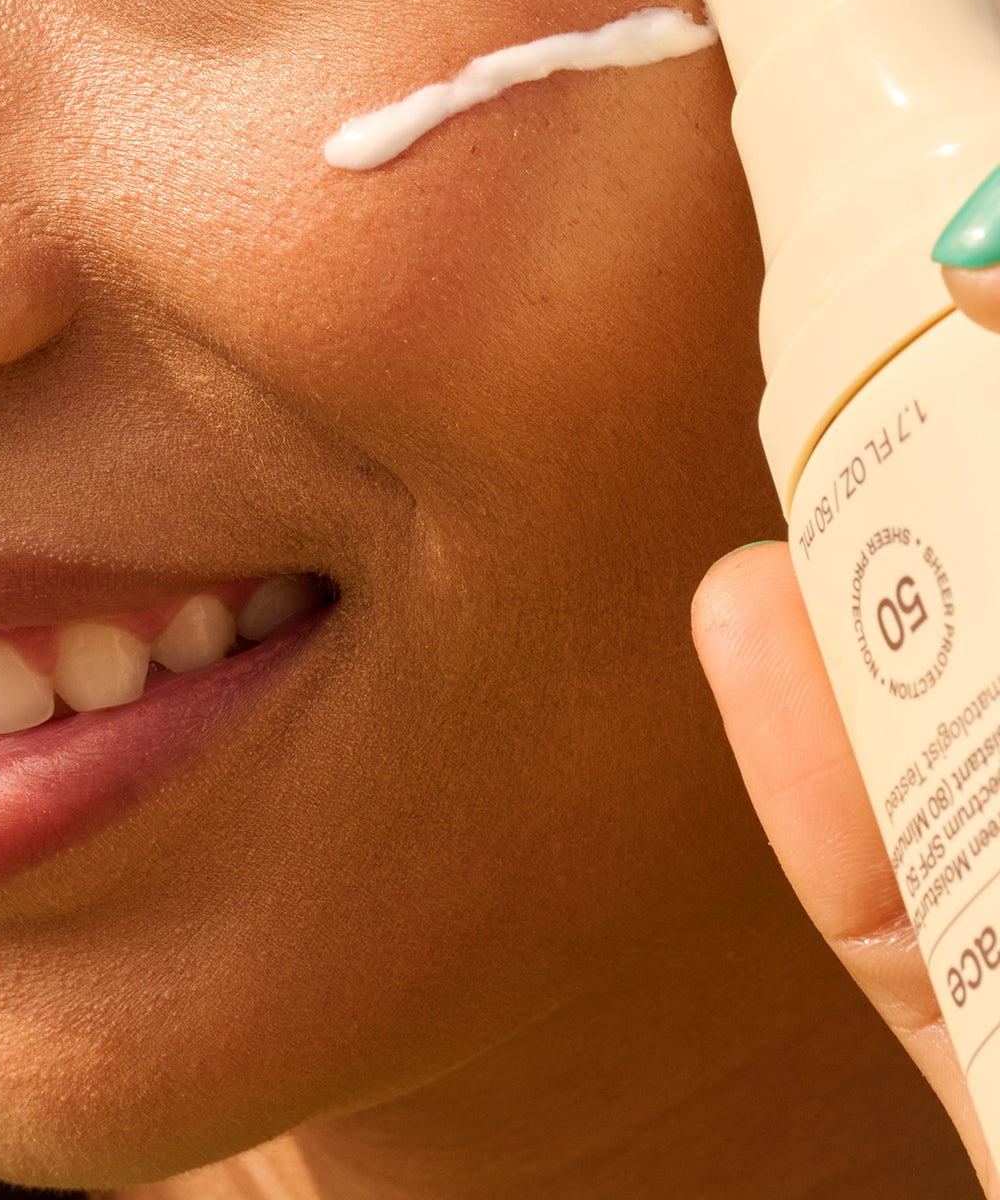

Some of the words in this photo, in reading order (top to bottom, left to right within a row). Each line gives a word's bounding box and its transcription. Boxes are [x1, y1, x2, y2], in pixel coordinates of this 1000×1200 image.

[898, 399, 928, 443] 1.7
[864, 428, 893, 464] FL
[839, 456, 866, 499] OZ
[814, 496, 834, 533] 50
[799, 519, 815, 561] mL
[866, 527, 911, 556] SHEER
[923, 546, 955, 616] SHEER
[852, 551, 880, 679] PROTECTION
[877, 575, 928, 652] 50
[889, 622, 955, 700] PROTECTION
[884, 762, 927, 825] Tested
[928, 777, 954, 820] (80
[943, 768, 1000, 841] ectrum
[918, 834, 946, 880] SPF
[905, 866, 921, 897] 50
